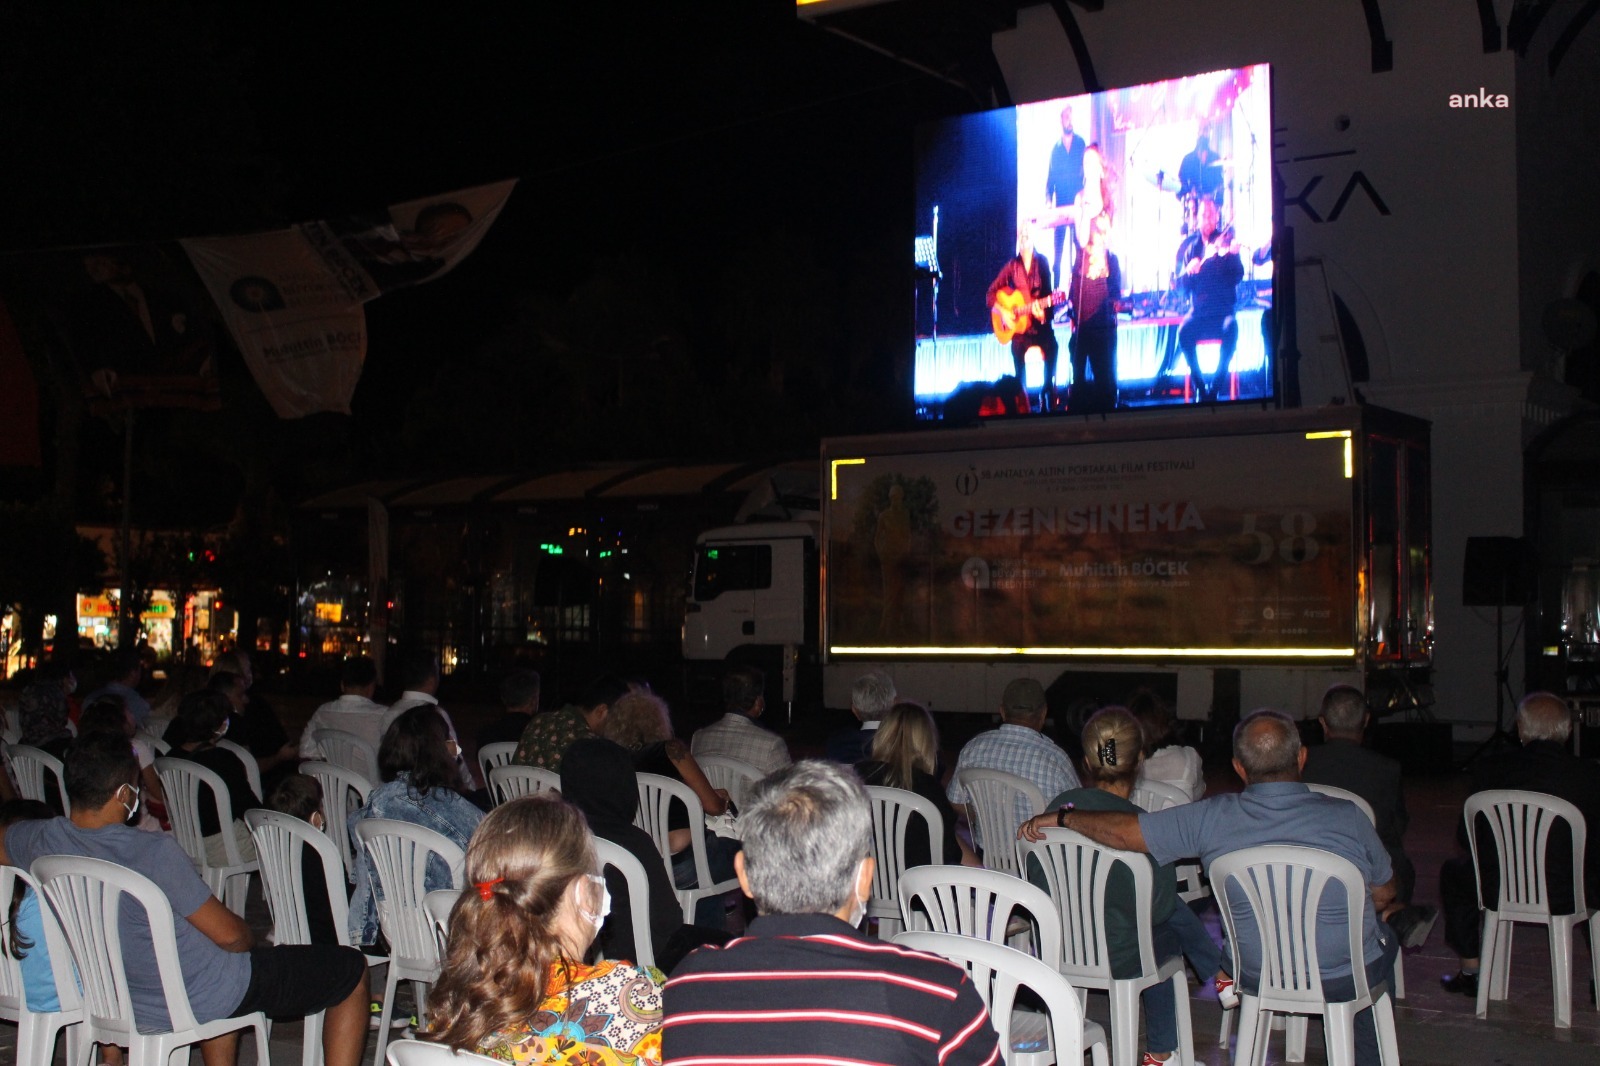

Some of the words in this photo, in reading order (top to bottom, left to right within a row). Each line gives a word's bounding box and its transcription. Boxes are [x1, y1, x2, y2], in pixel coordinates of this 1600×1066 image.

[993, 468, 1035, 479] ANTALYA
[1038, 466, 1065, 477] ALTIN
[1068, 463, 1118, 476] PORTAKAL
[1227, 511, 1320, 565] 58
[1059, 561, 1128, 577] Muhittin
[1131, 557, 1189, 576] BÖCEK
